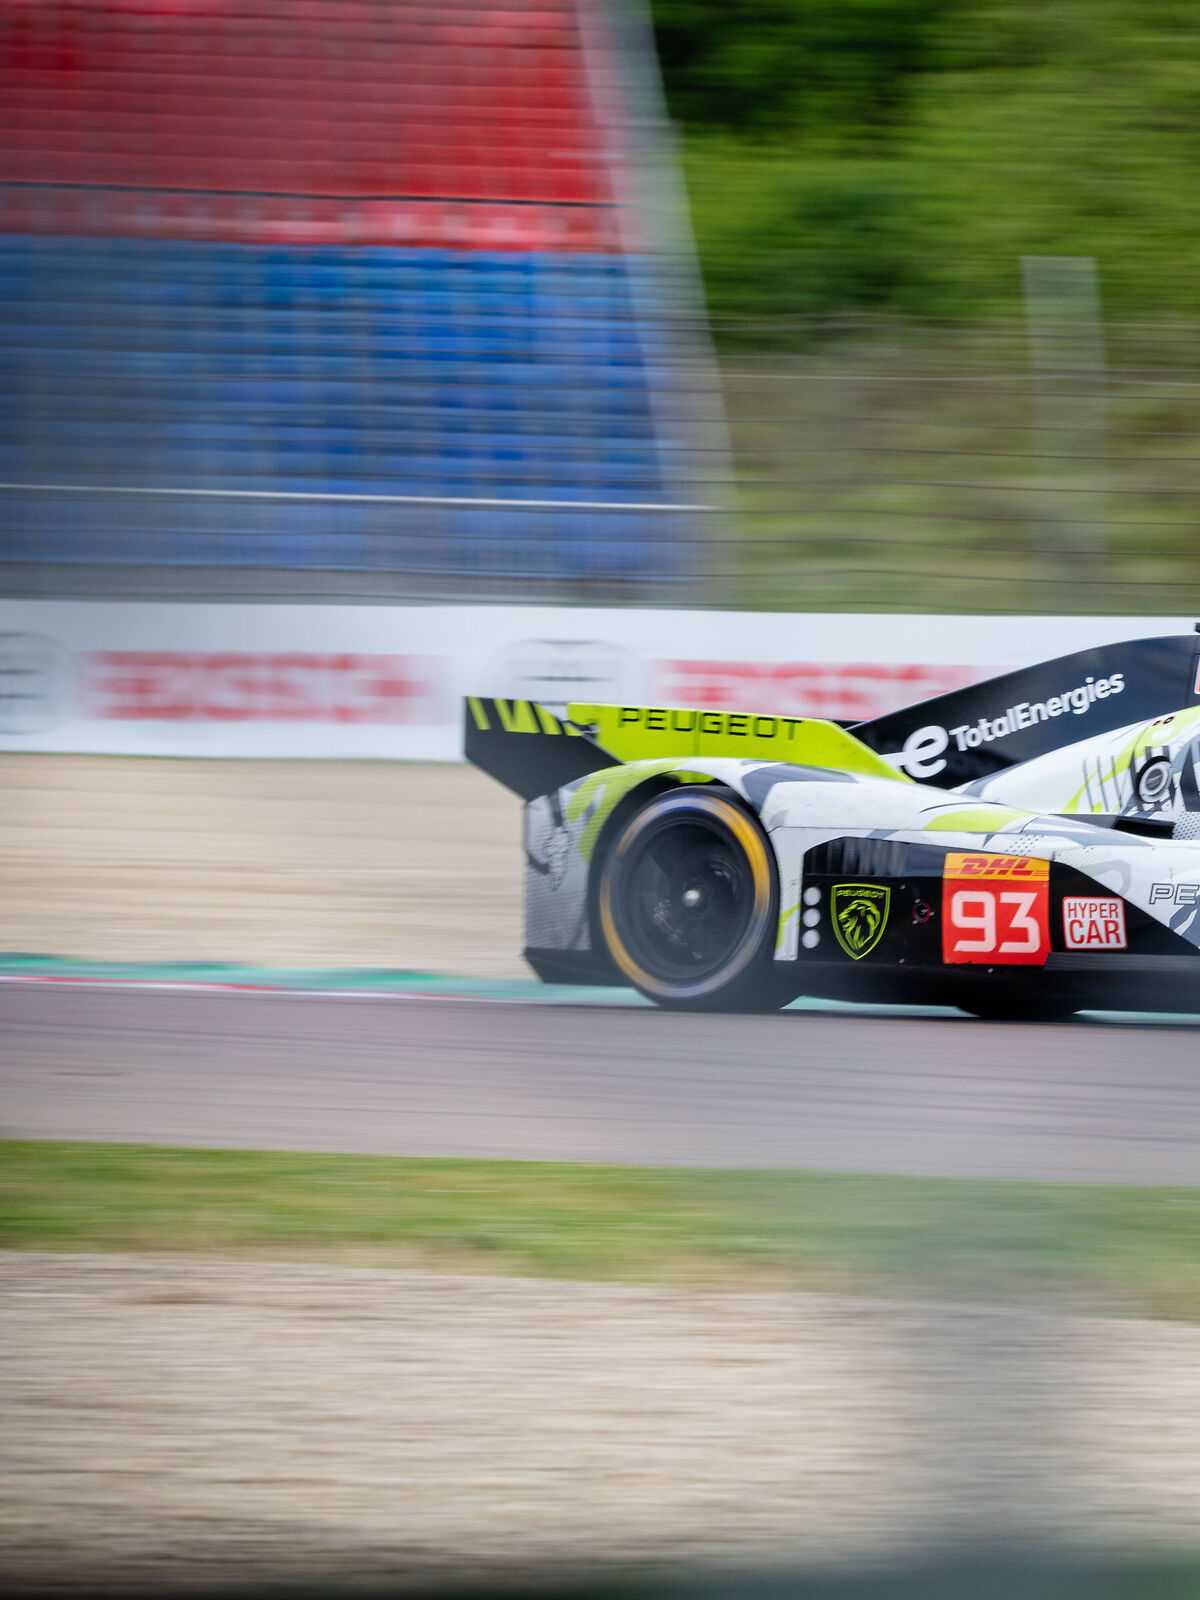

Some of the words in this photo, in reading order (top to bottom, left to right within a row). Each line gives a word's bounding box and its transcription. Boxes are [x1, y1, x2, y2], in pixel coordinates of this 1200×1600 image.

[618, 707, 803, 741] PEUGEOT
[949, 673, 1126, 752] TotalEnergies
[960, 858, 1033, 876] DHL
[836, 889, 886, 899] PEUGEOT
[951, 890, 1041, 953] 93
[1067, 902, 1119, 919] HYPER
[1069, 919, 1121, 944] CAR
